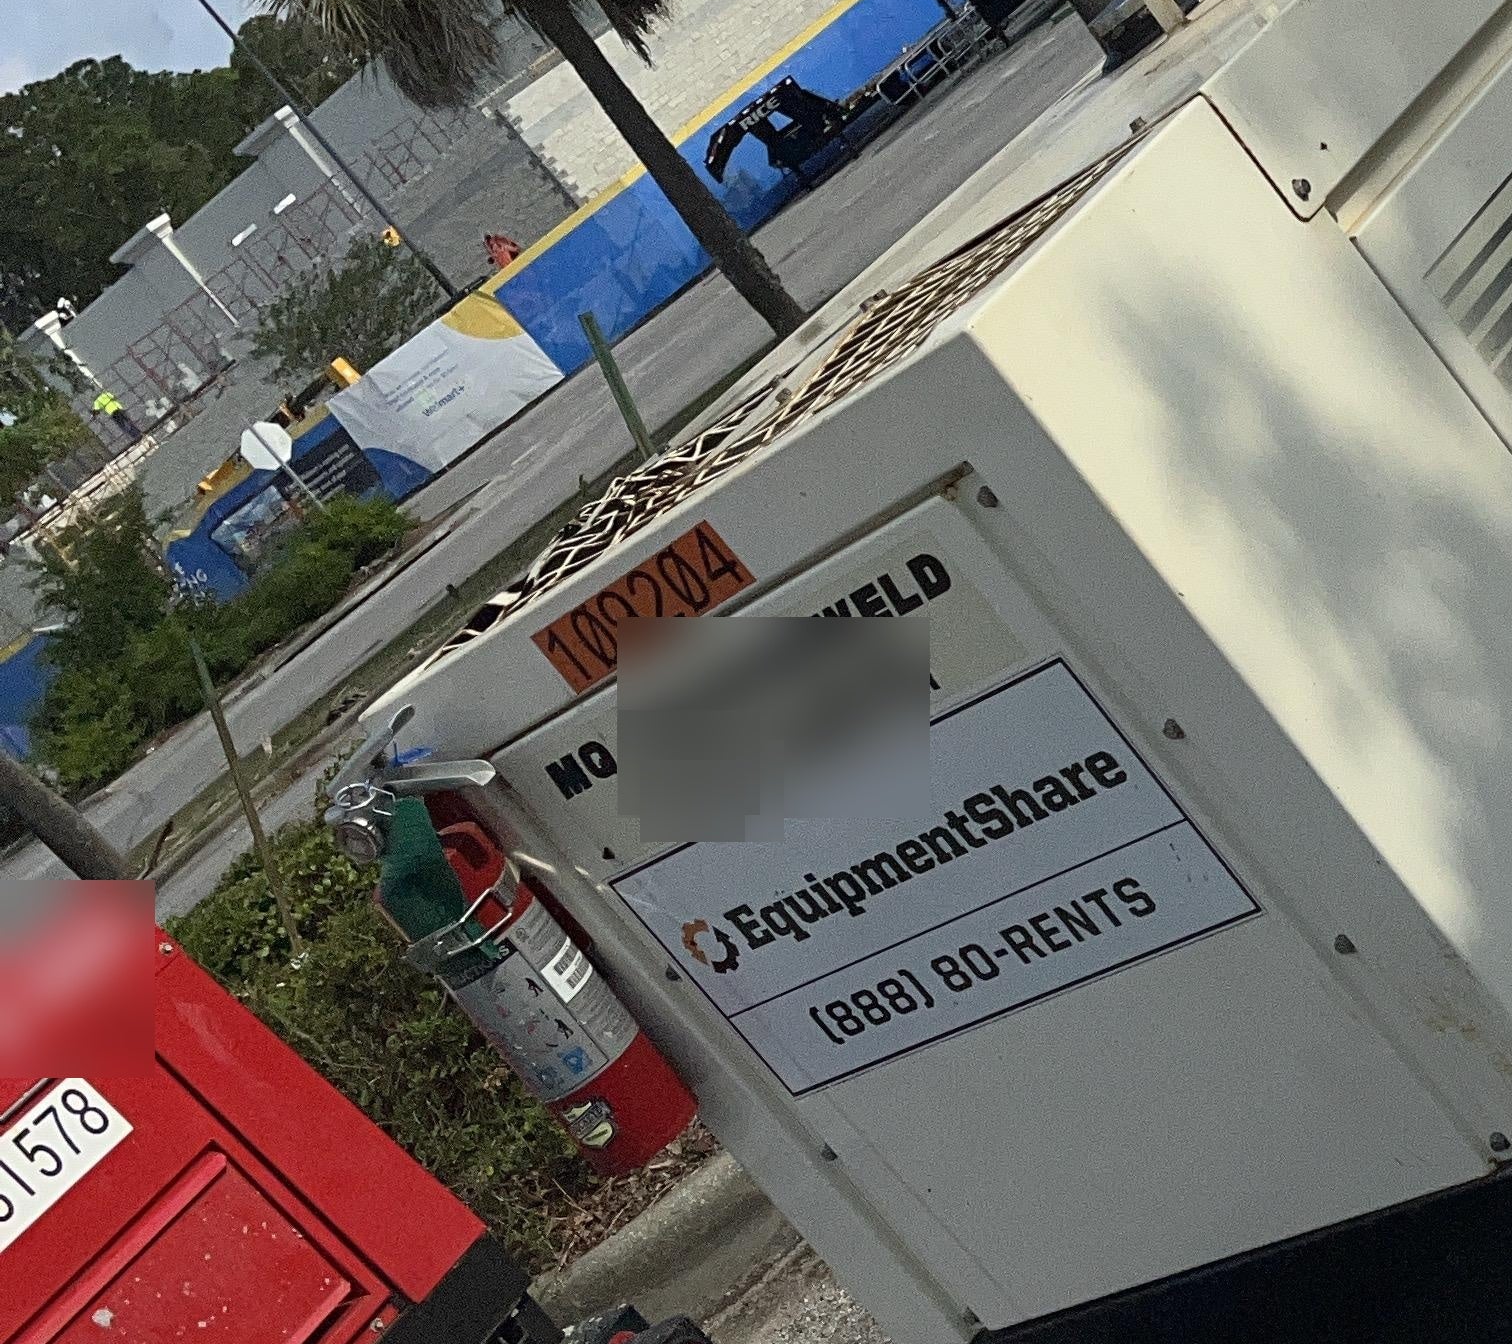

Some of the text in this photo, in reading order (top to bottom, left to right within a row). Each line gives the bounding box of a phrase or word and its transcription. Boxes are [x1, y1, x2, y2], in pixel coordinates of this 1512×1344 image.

[739, 96, 781, 131] RICE
[724, 750, 1128, 943] EquipmentShare
[809, 877, 1157, 1045] (888) 80-RENTS
[0, 1089, 109, 1223] 1578
